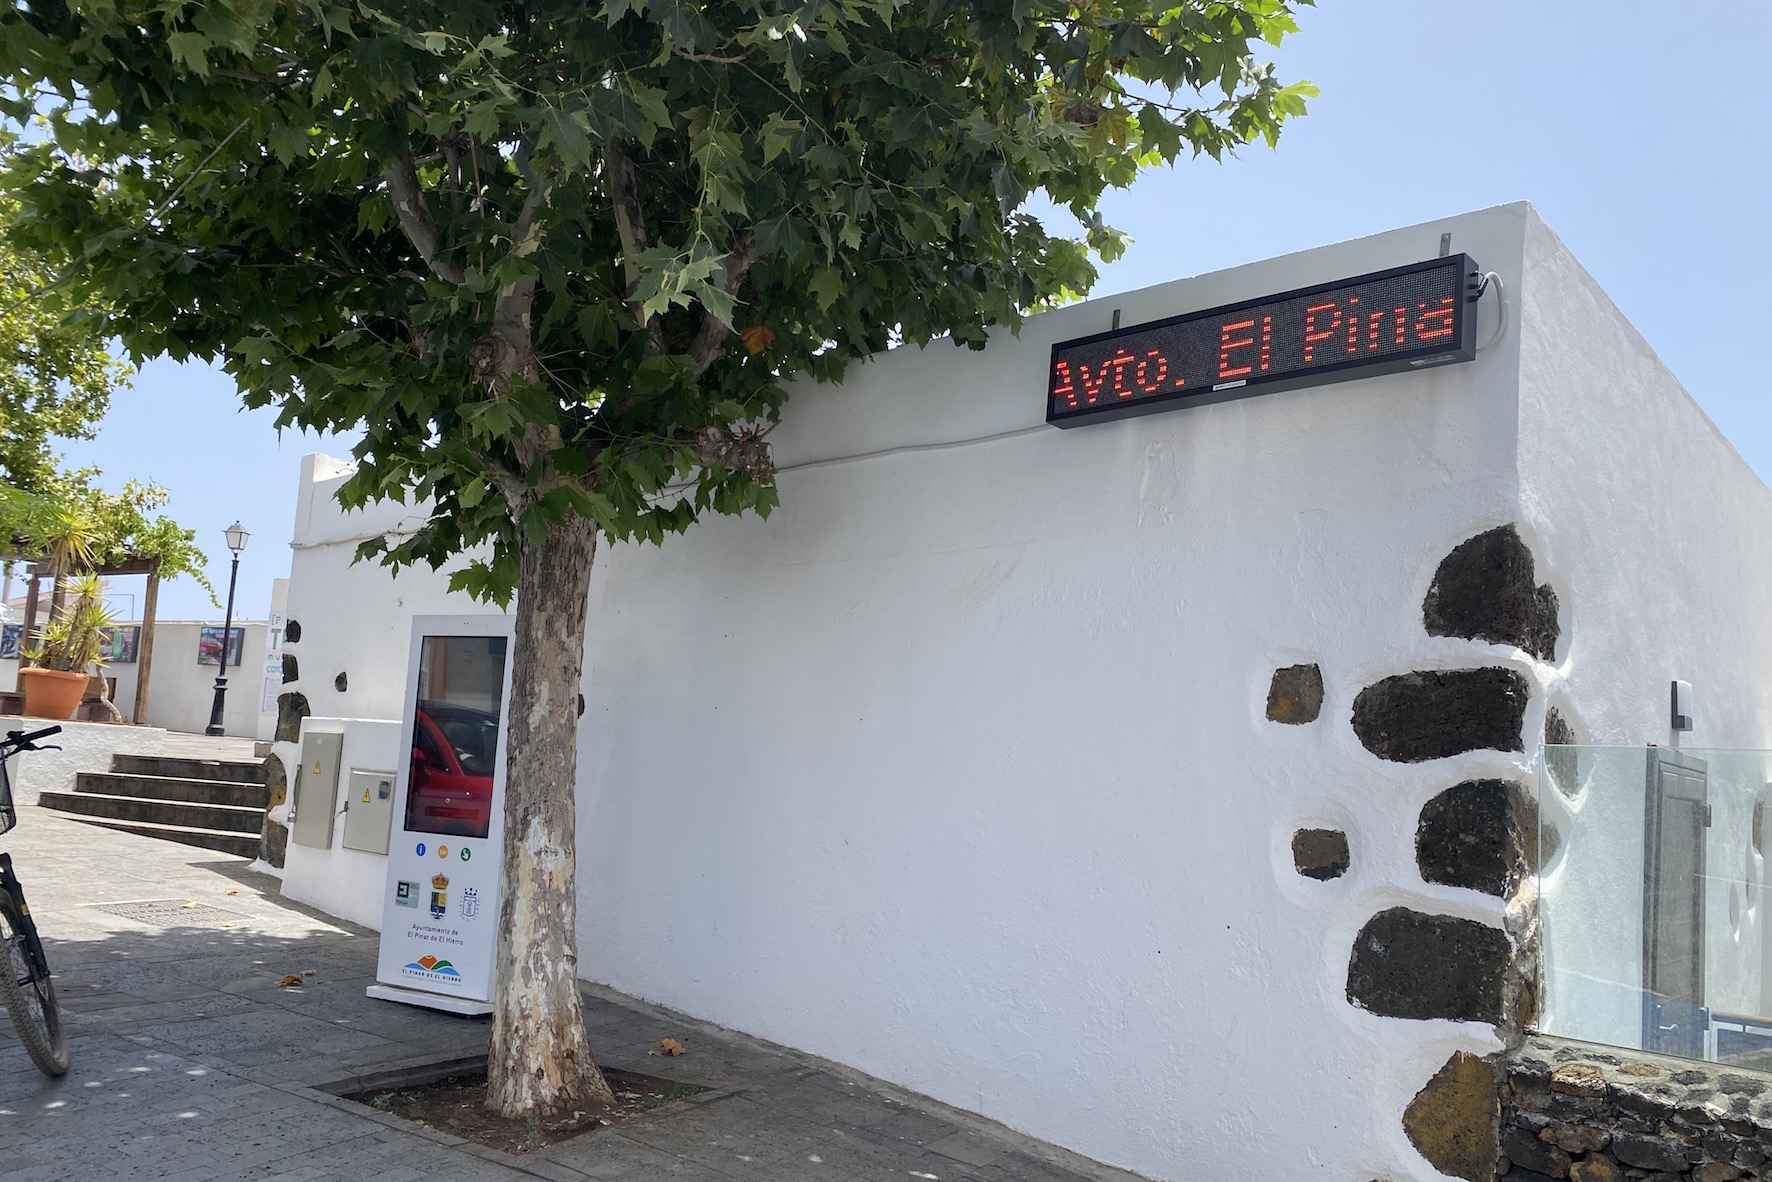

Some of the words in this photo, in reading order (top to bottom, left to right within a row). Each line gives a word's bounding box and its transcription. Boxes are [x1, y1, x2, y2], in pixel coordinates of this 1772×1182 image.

[1219, 316, 1272, 378] El
[412, 923, 451, 935] Ayuntamiento
[414, 932, 430, 941] Pinar
[438, 935, 445, 943] El
[445, 937, 464, 946] Hierro
